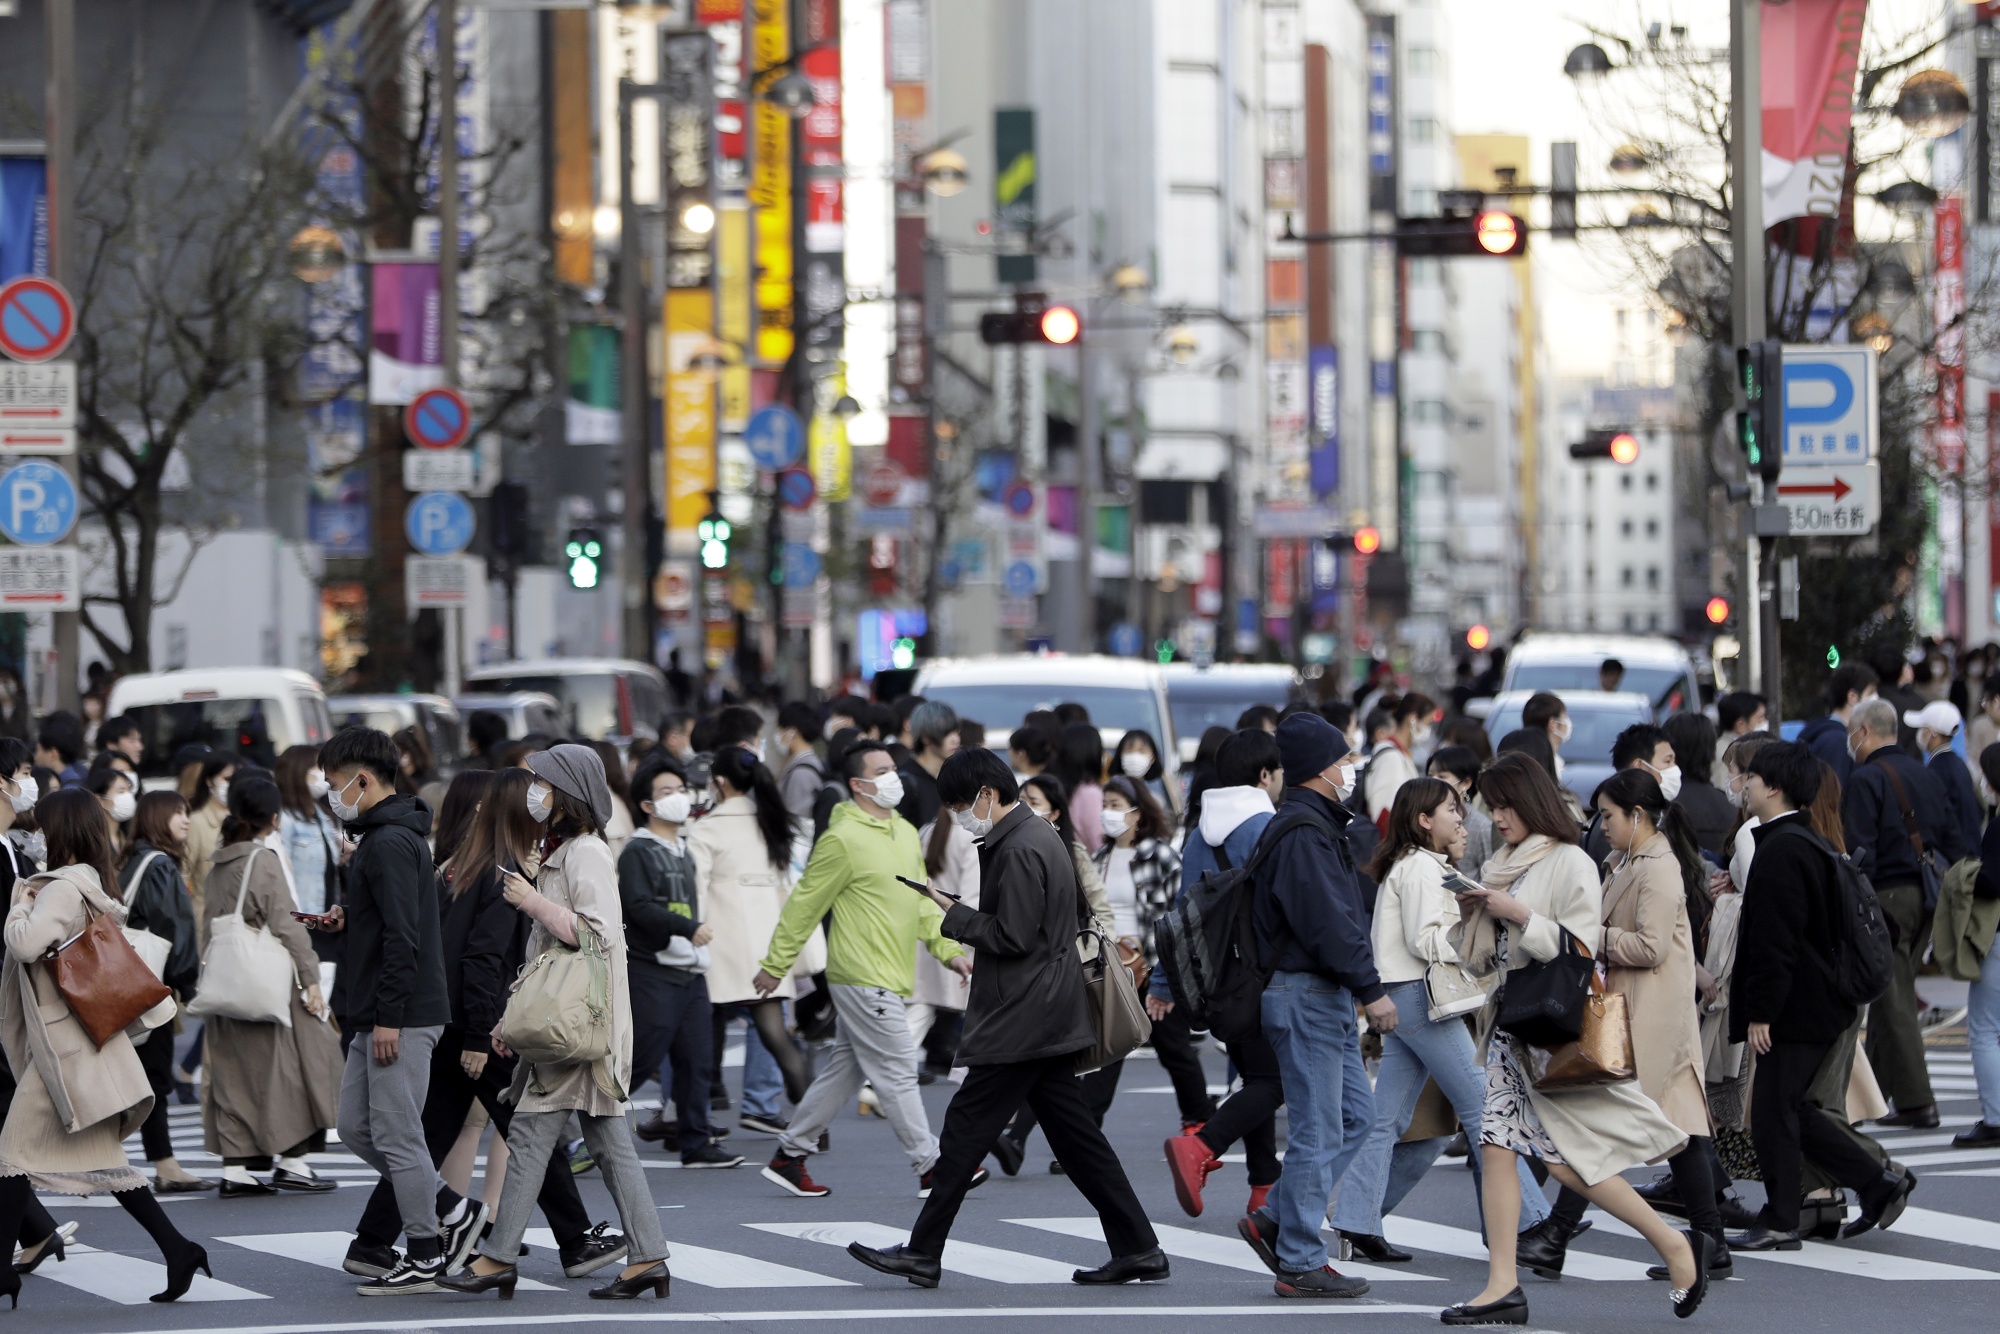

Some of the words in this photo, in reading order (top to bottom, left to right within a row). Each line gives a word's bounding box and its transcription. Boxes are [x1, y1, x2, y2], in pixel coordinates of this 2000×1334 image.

[1823, 10, 1864, 113] OKYO
[1807, 124, 1849, 216] 2020
[1782, 363, 1854, 453] P
[1799, 434, 1860, 455] 駐車場
[12, 482, 46, 534] P
[421, 503, 449, 549] P
[1789, 505, 1865, 530] 50m右折
